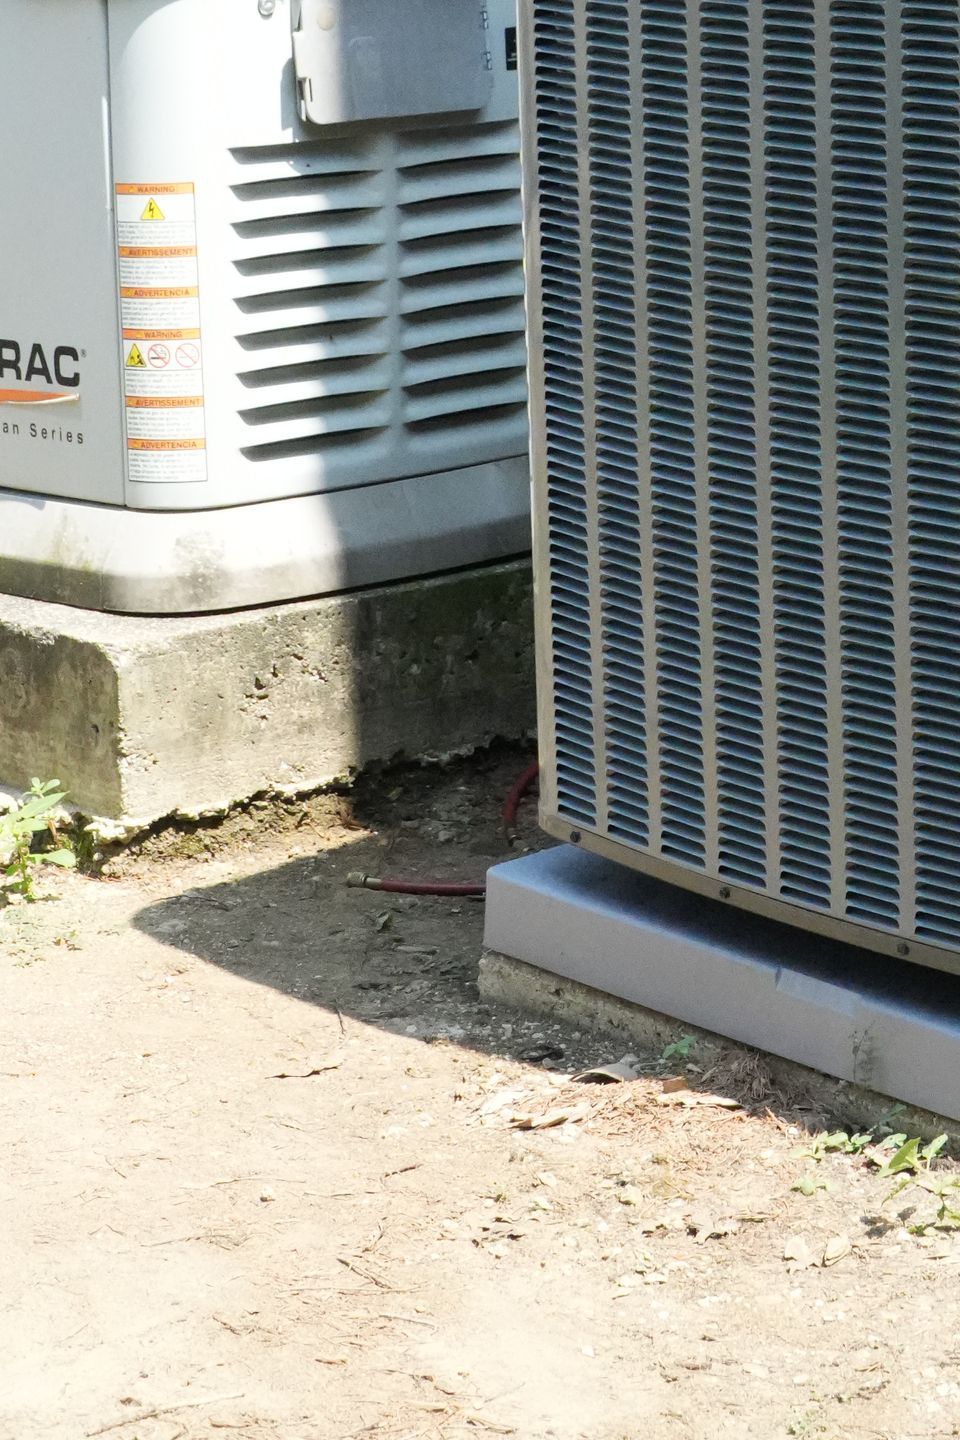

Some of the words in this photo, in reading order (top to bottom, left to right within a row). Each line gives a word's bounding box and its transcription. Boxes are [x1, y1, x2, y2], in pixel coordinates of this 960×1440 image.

[137, 185, 176, 193] WARNING
[128, 248, 193, 256] AVERTISSEMENT
[133, 289, 190, 297] ADVERTENCIA
[135, 398, 200, 406] AVERTISSEMENT
[29, 423, 84, 444] Series
[140, 441, 197, 449] ADVERTENCIA
